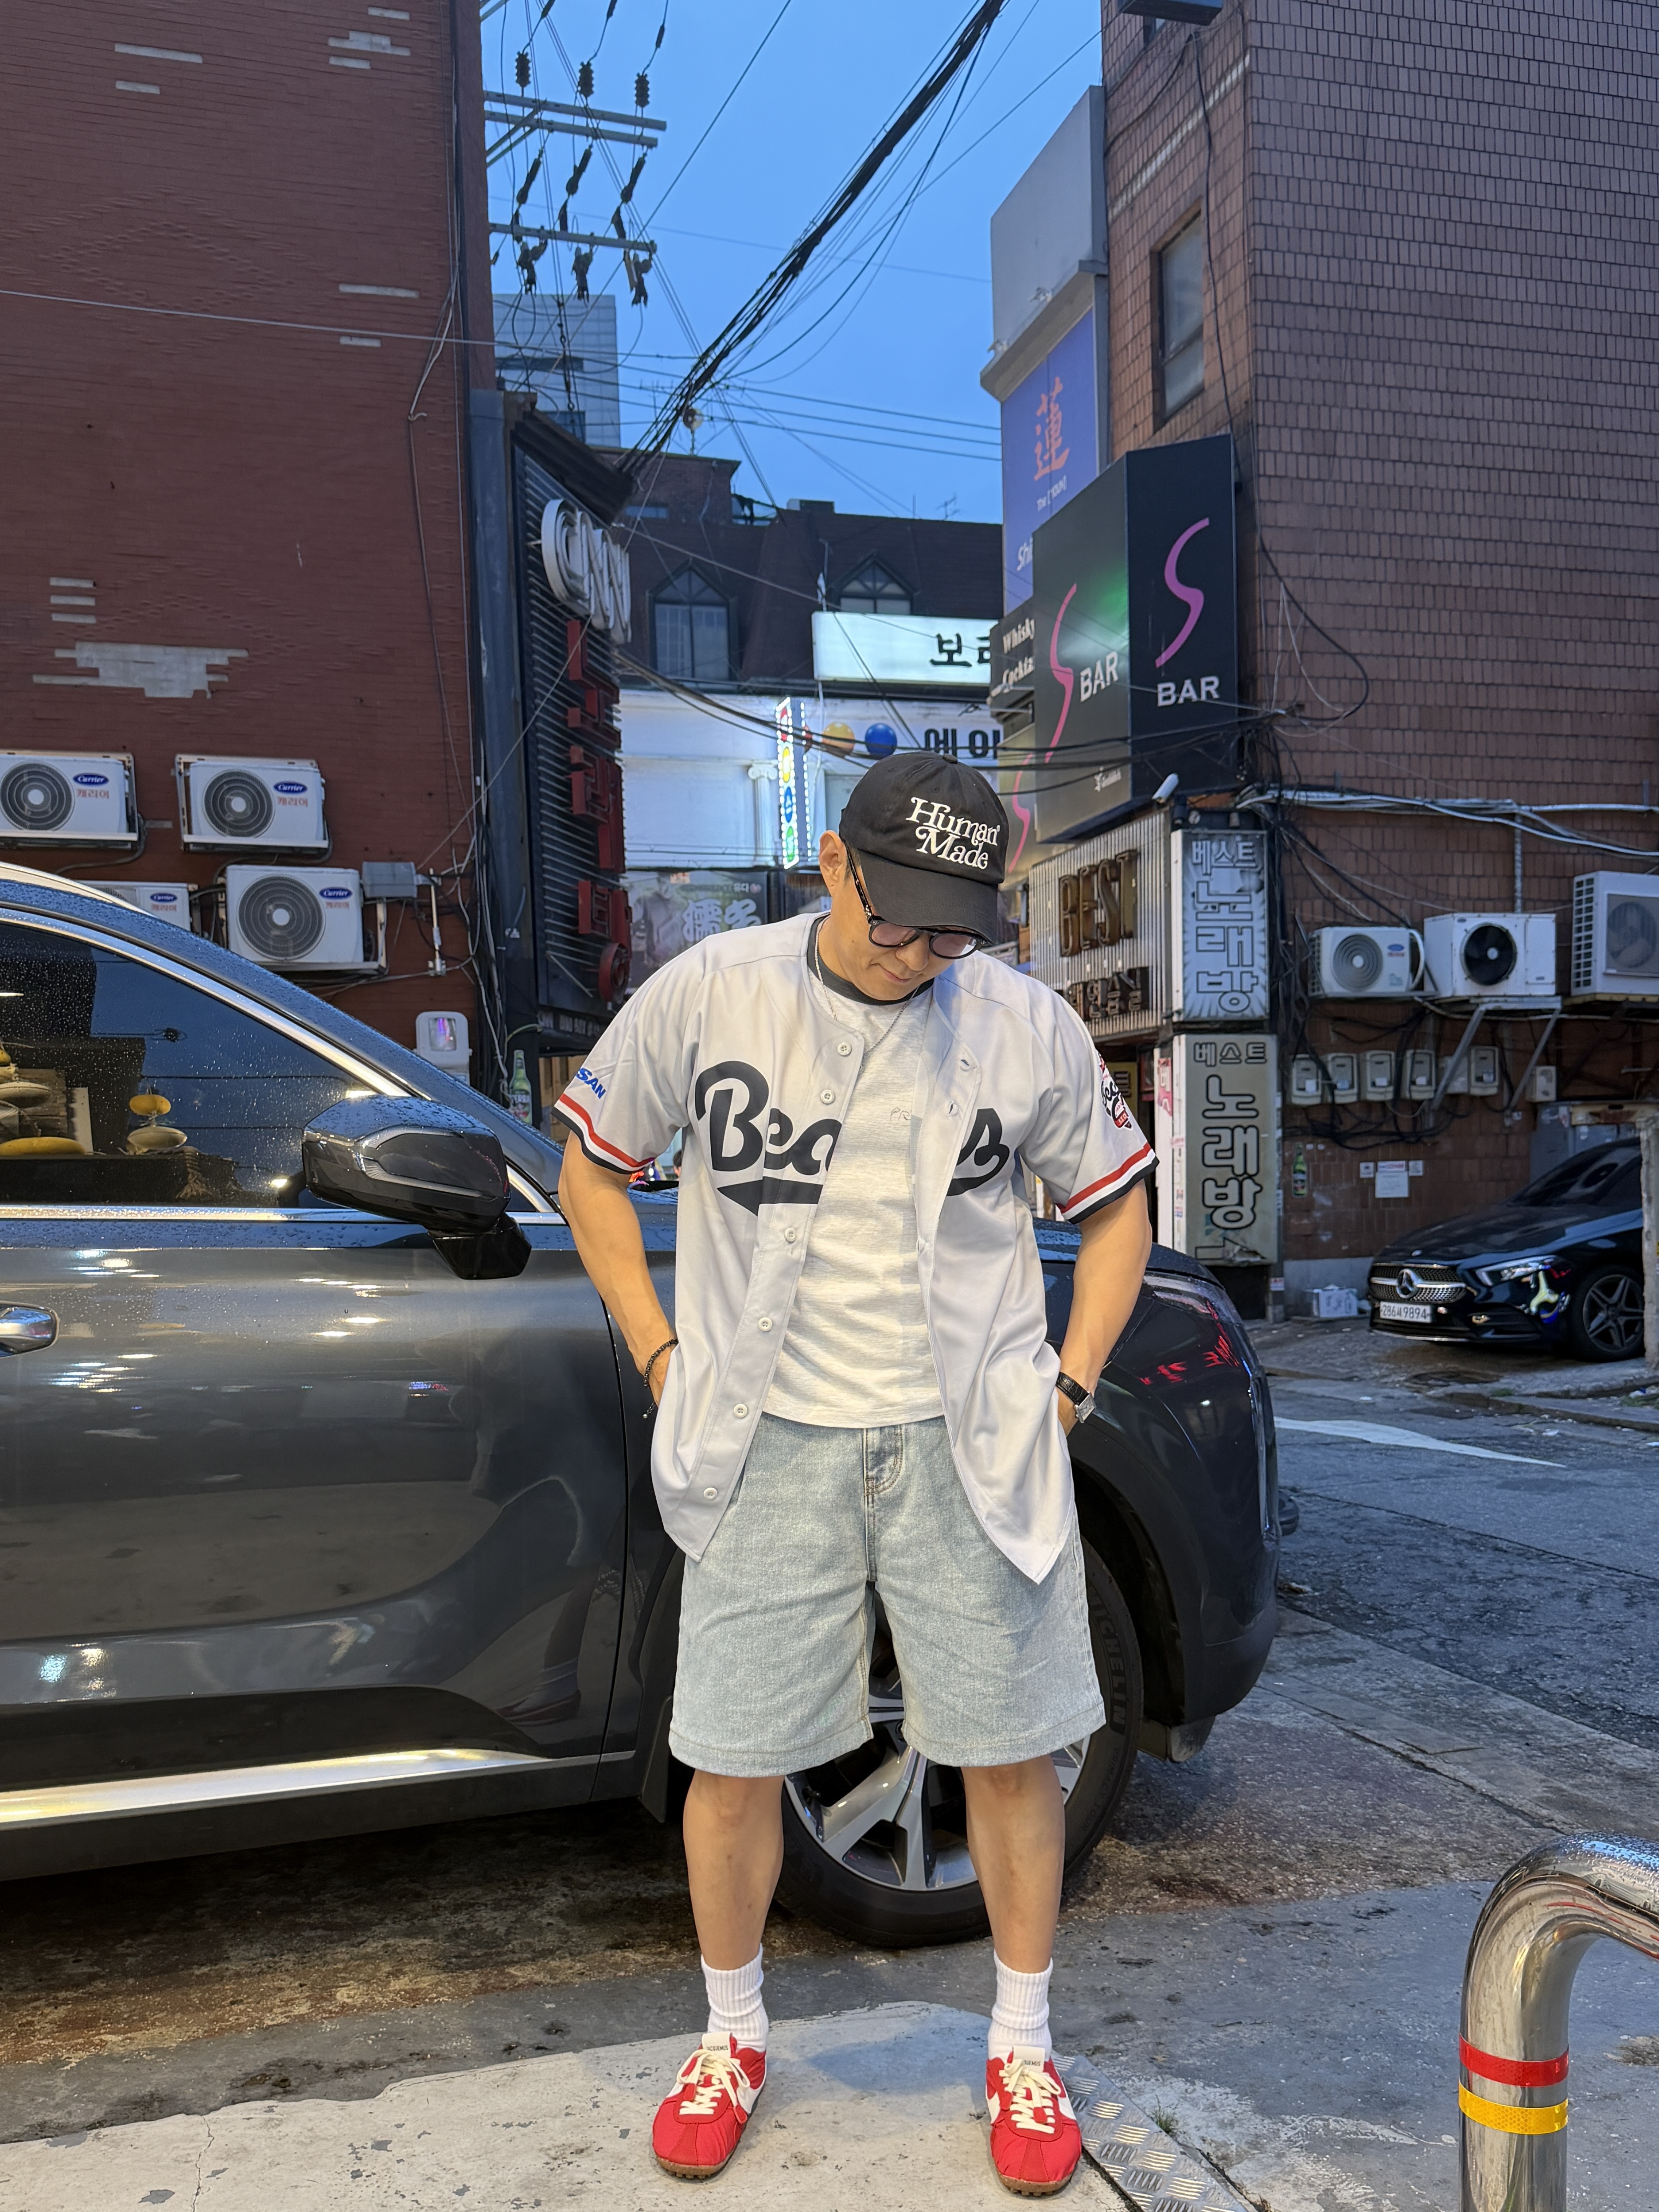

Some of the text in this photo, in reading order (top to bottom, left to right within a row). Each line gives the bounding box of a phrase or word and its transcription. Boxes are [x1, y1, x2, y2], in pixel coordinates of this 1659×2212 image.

[1003, 618, 1035, 654] Whisky
[1080, 651, 1118, 702] BAR
[1157, 675, 1220, 707] BAR
[567, 620, 633, 1004] 노래방
[906, 797, 998, 846] Human
[915, 826, 989, 870] Made
[1192, 840, 1257, 876] 베스트
[1059, 849, 1141, 957] BEST
[1196, 881, 1259, 1014] 노래방
[1193, 1041, 1267, 1067] 베스트
[1202, 1074, 1263, 1230] 노래방
